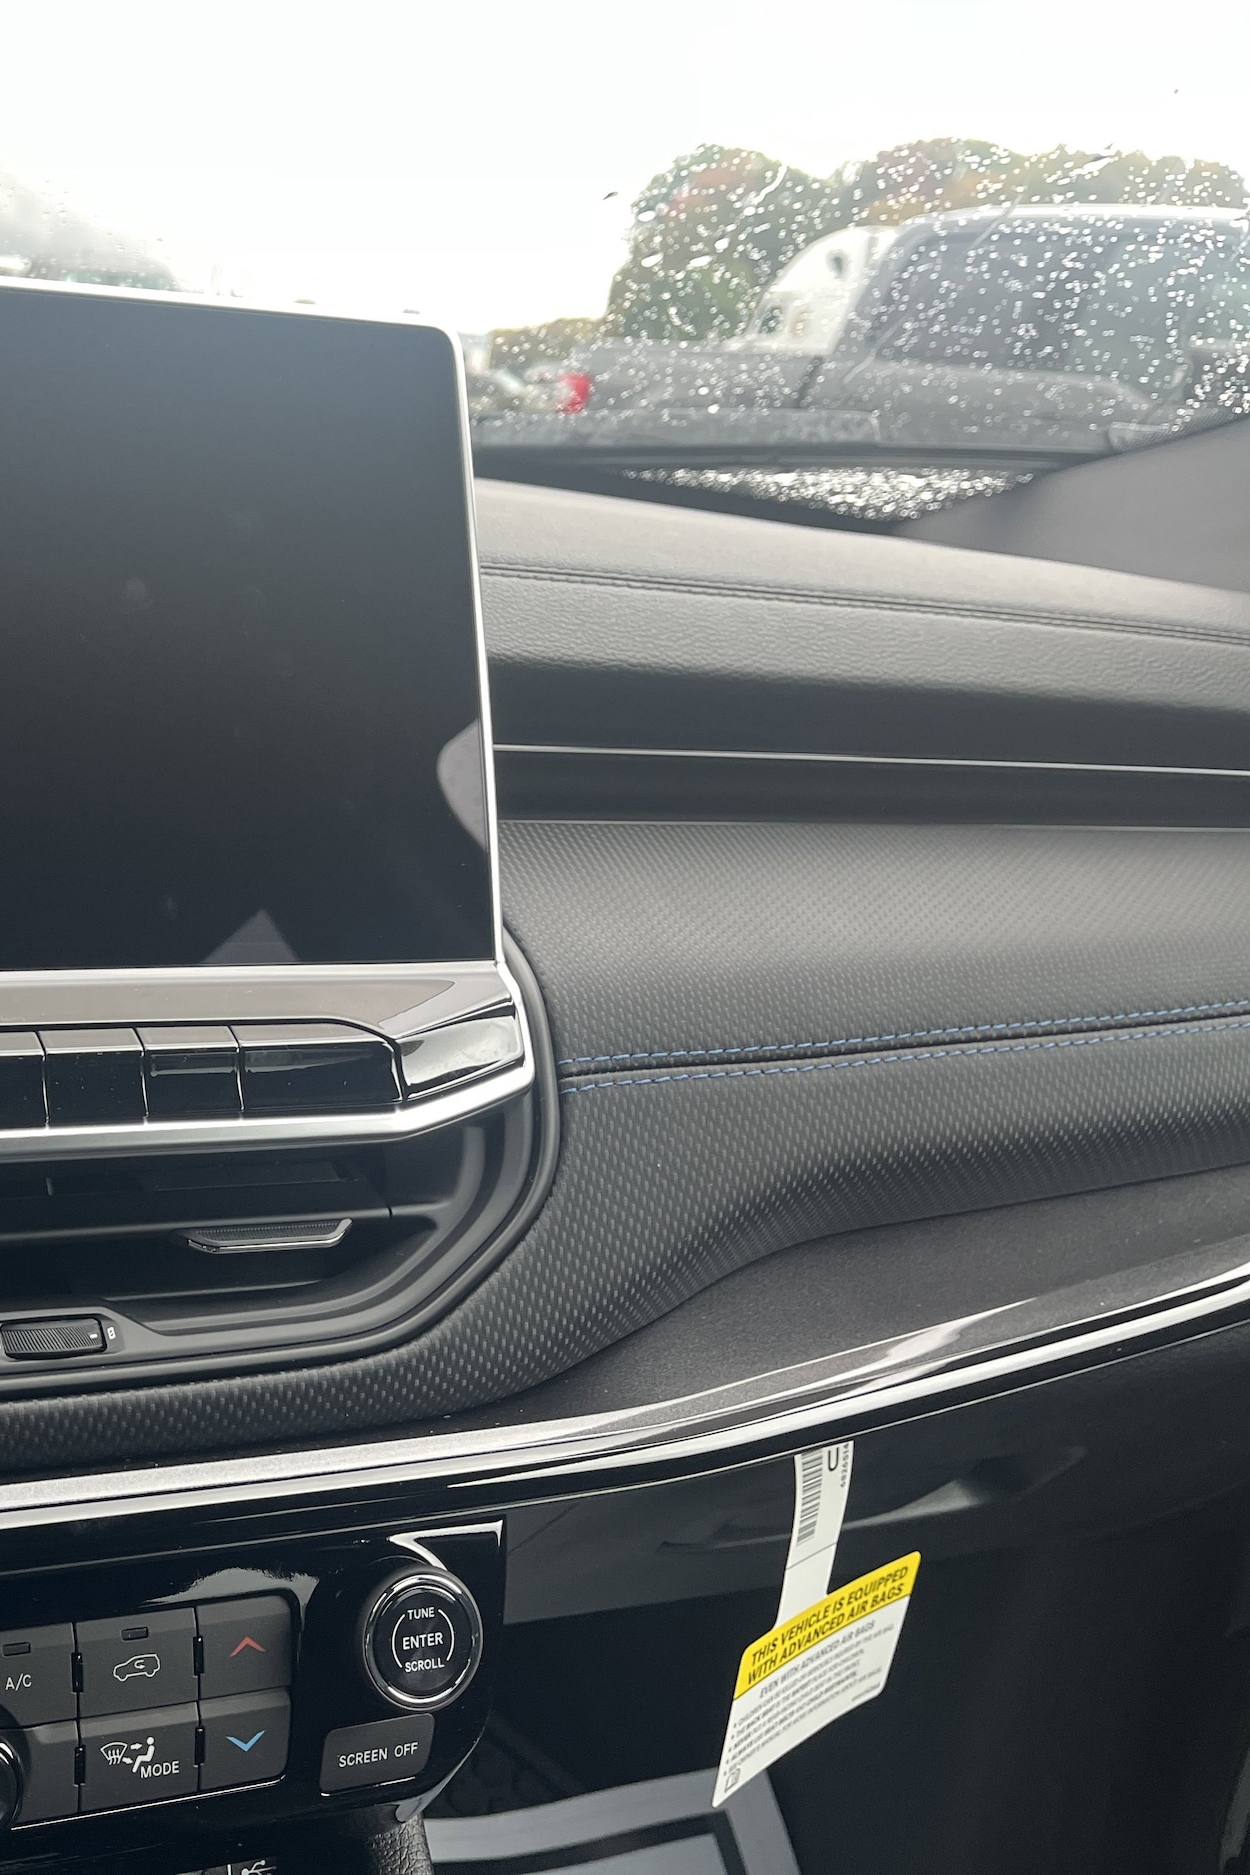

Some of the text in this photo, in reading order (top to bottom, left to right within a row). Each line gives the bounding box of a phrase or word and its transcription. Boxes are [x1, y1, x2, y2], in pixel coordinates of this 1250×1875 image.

[828, 1447, 840, 1472] U
[407, 1606, 435, 1621] TUNE
[751, 1566, 909, 1668] THIS VEHICLE IS EQUIPPED
[402, 1632, 443, 1651] ENTER
[747, 1582, 905, 1686] WITH ADVANCED AIR BAGS
[404, 1656, 445, 1674] SCROLL
[4, 1673, 33, 1692] A/C
[338, 1741, 419, 1769] SCREEN OFF
[139, 1759, 180, 1780] MODE
